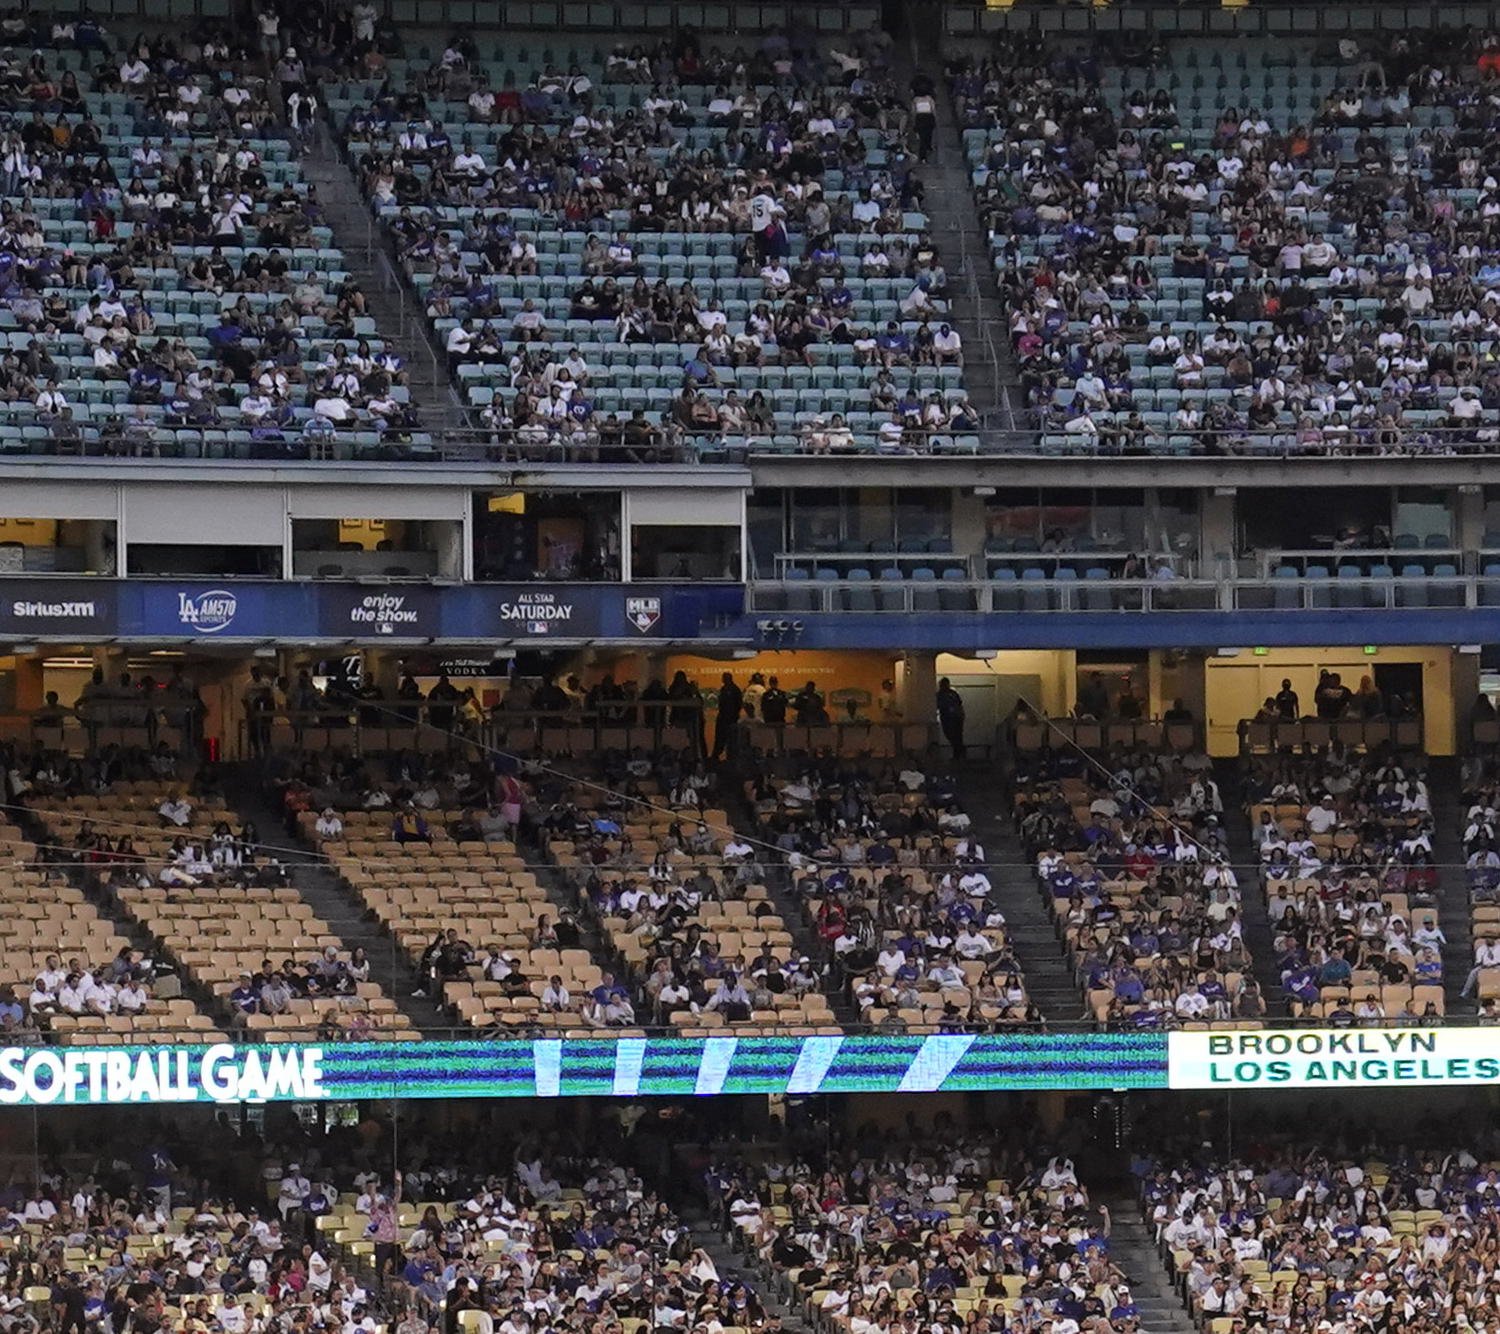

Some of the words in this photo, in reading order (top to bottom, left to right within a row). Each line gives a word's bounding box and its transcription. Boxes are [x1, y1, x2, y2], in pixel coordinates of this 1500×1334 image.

[363, 593, 404, 612] enjoy
[518, 594, 537, 604] ALL
[537, 593, 556, 604] STAR
[628, 598, 660, 610] MLB
[200, 599, 237, 617] AM570
[351, 607, 375, 623] the
[376, 608, 418, 624] show.
[501, 603, 573, 620] SATURDAY
[446, 667, 487, 676] VODKA
[1208, 1033, 1437, 1056] BROOKLYN
[200, 1043, 326, 1101] GAME
[1210, 1060, 1292, 1083] LOS
[1304, 1058, 1500, 1082] ANGELES
